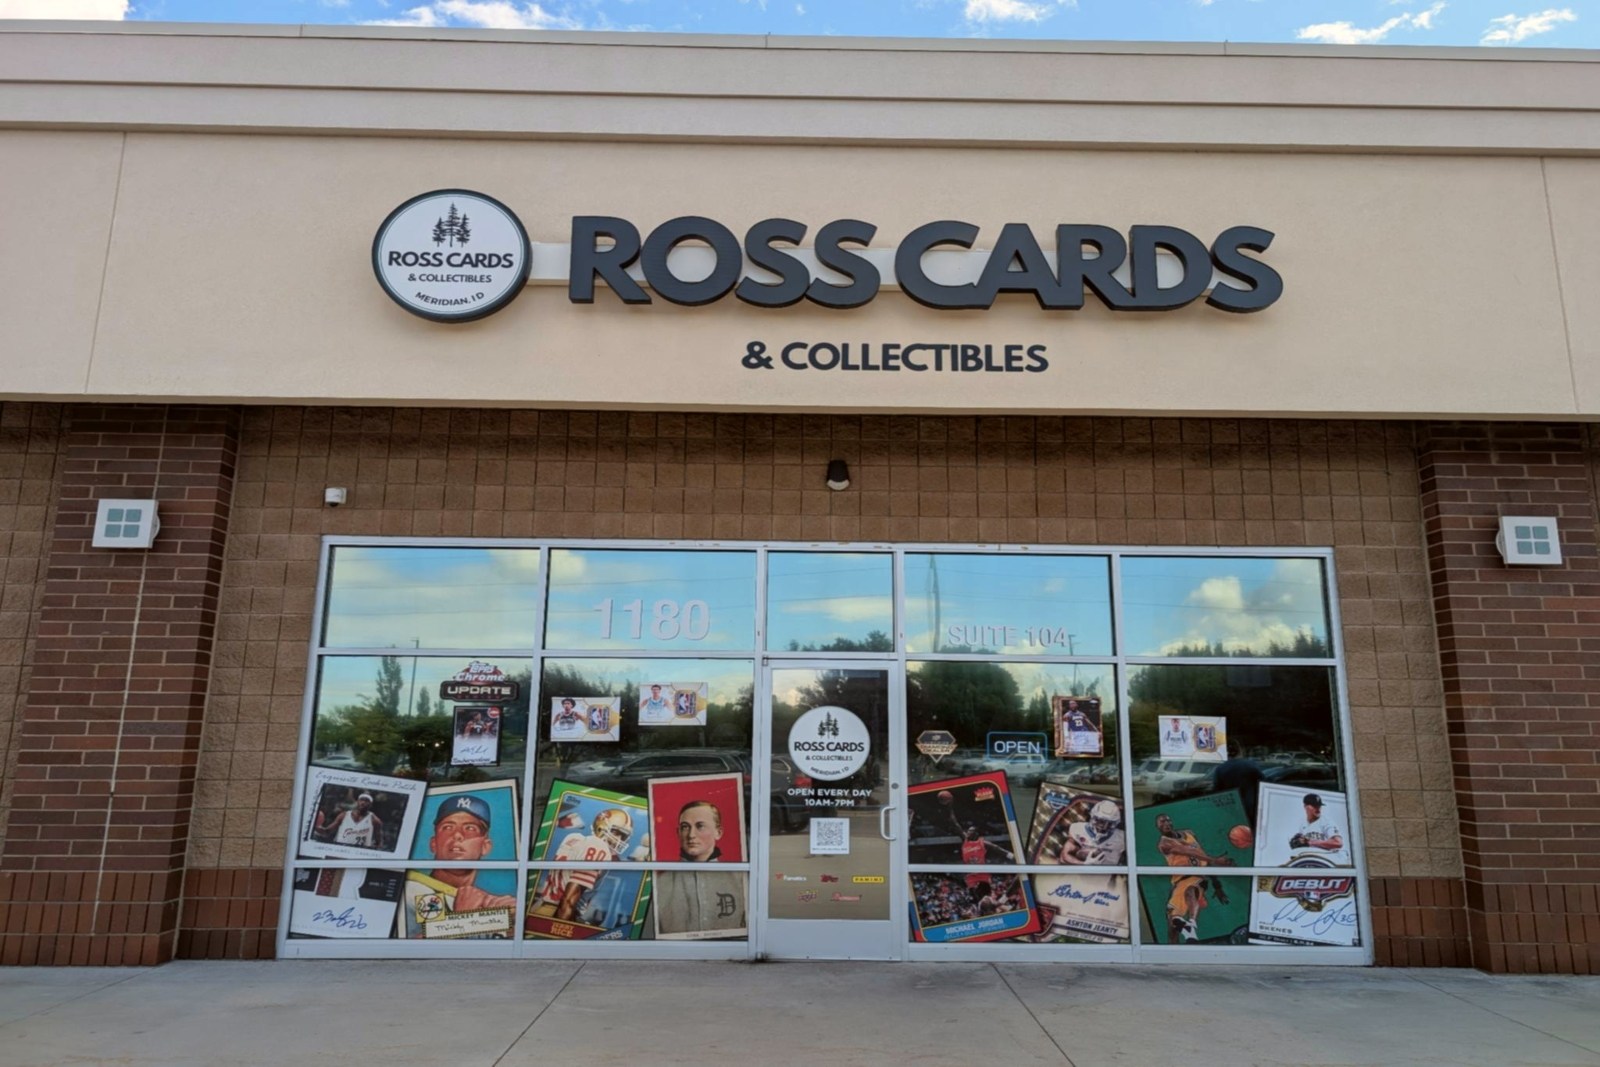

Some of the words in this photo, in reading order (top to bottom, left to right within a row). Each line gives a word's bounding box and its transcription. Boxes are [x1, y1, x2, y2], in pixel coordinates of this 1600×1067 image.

[388, 251, 443, 267] ROSS
[446, 252, 514, 268] CARDS
[568, 215, 881, 308] ROSS
[895, 220, 1284, 313] CARDS
[408, 273, 416, 282] &
[418, 273, 492, 283] COLLECTIBLES
[471, 291, 485, 302] ID
[741, 341, 773, 370] &
[781, 341, 1049, 372] COLLECTIBLES
[593, 598, 711, 641] 1180
[948, 625, 1017, 647] SUITE
[1024, 625, 1068, 647] 104
[447, 686, 511, 695] UPDATE
[794, 742, 825, 752] ROSS
[826, 742, 865, 752] CARDS
[994, 740, 1041, 754] OPEN
[787, 788, 815, 796] OPEN
[817, 789, 850, 797] EVERY
[852, 789, 873, 797] DAY
[804, 799, 855, 807] 10AM-7PM
[1281, 879, 1346, 890] DEBUT
[945, 923, 974, 934] MICHAEL
[1066, 919, 1093, 929] ASHTON
[1093, 925, 1118, 935] JEANTY
[1259, 925, 1293, 934] SKENES
[550, 928, 574, 938] RICE
